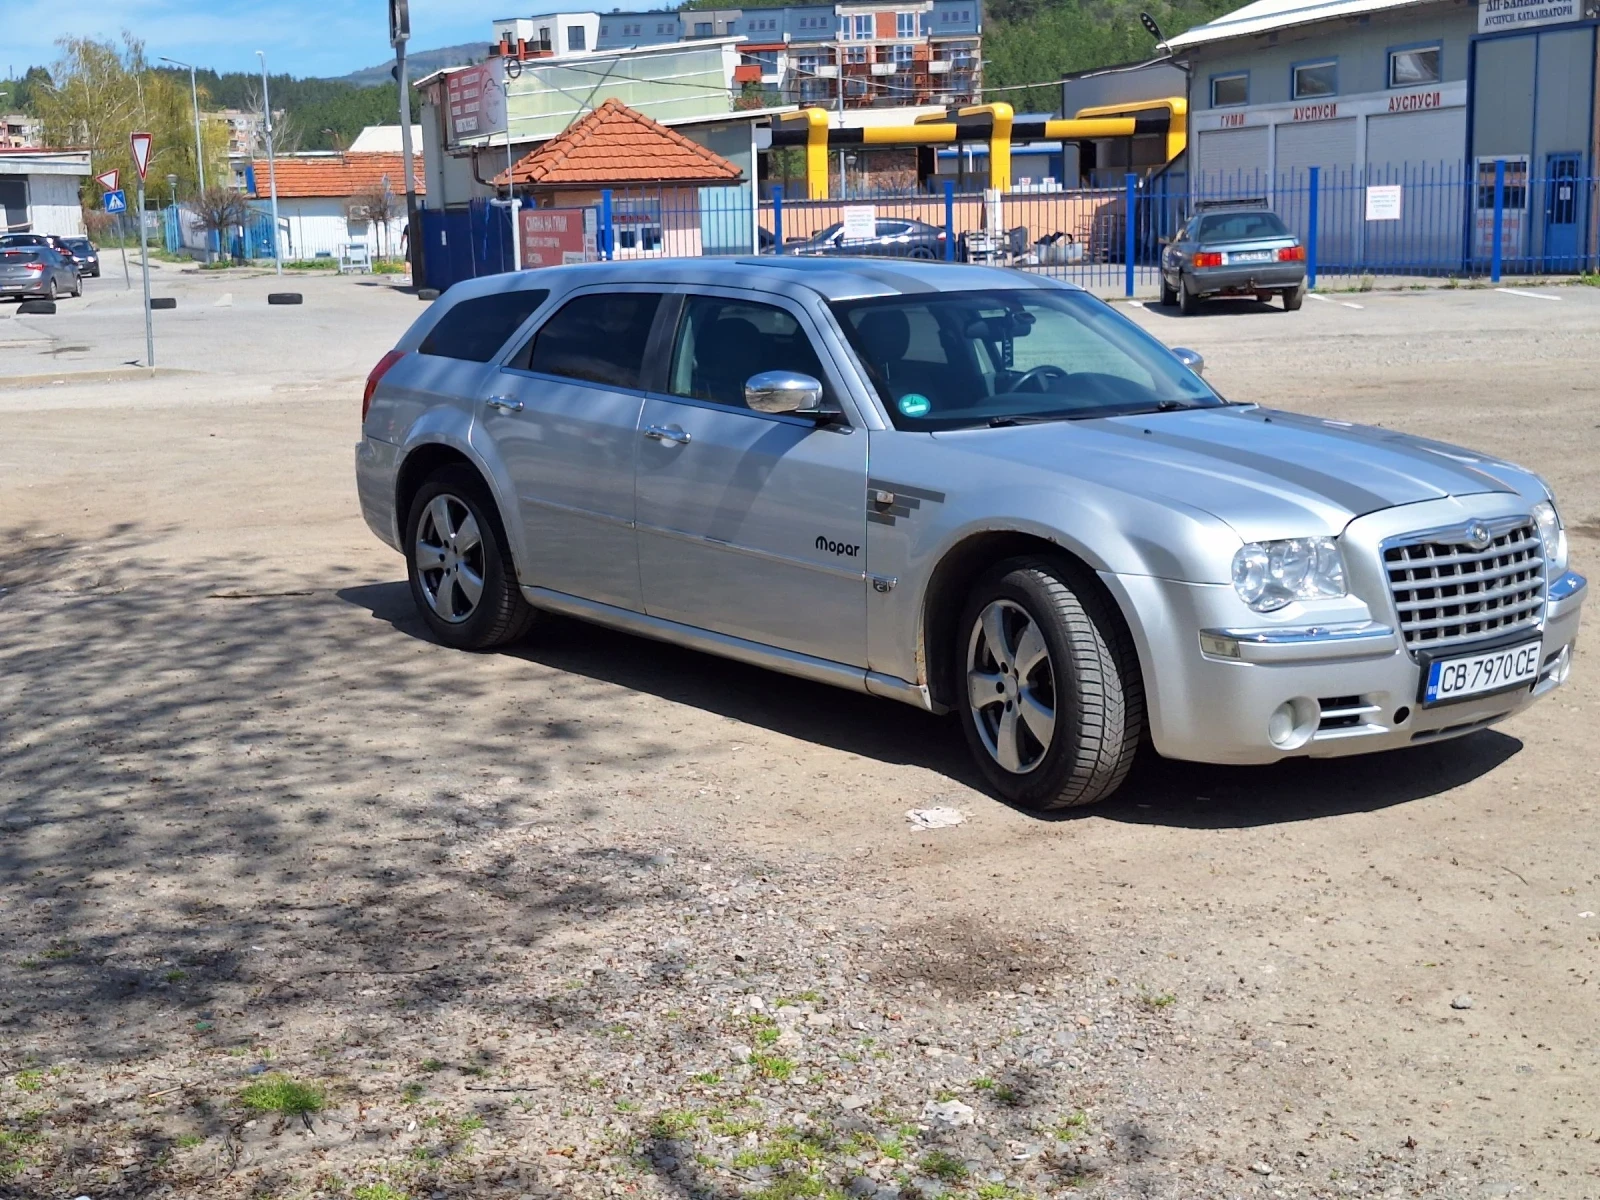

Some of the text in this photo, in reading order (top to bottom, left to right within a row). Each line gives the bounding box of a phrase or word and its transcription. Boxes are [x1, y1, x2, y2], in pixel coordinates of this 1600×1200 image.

[1517, 5, 1572, 21] КАТАЛИЗАТОРИ
[1388, 92, 1440, 112] АУСПУСИ
[1220, 114, 1244, 127] ГУМИ
[1294, 104, 1337, 120] АУСПУСИ
[816, 536, 860, 557] Mopar
[1441, 646, 1538, 693] CB 7970 CE
